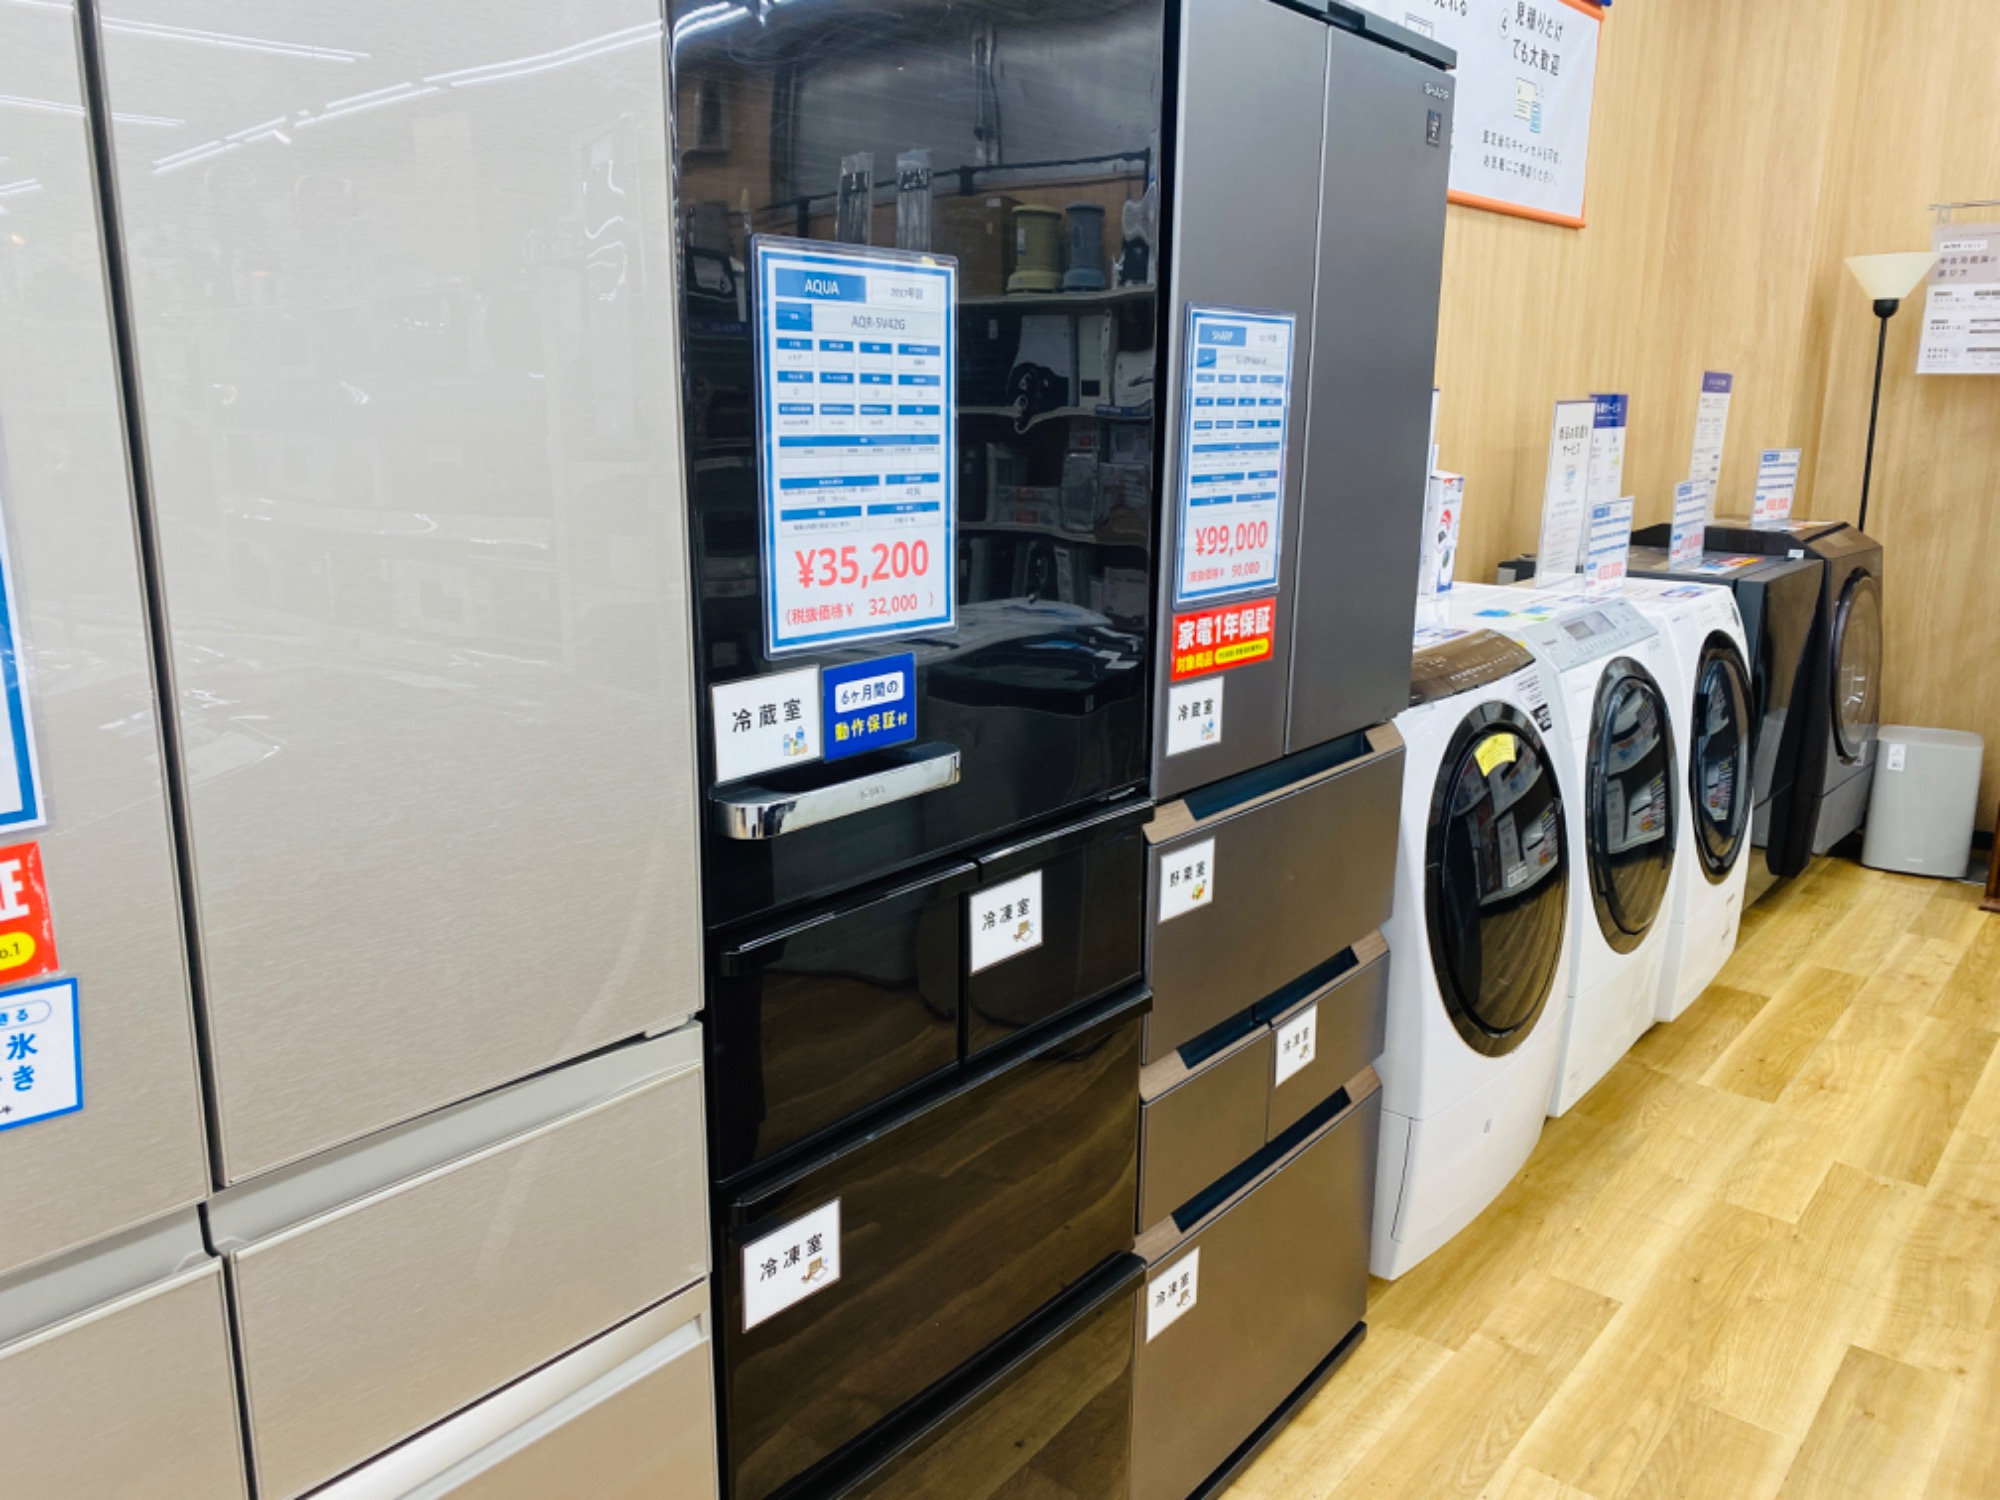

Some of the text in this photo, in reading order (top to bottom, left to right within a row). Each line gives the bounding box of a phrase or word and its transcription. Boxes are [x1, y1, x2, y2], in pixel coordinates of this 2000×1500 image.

[804, 279, 839, 295] AQUA
[1195, 520, 1269, 556] ¥99,000
[794, 539, 929, 589] ¥35,200
[869, 593, 918, 617] 32,000
[1177, 605, 1271, 650] 家電1年保証
[732, 698, 802, 733] 冷蔵室
[834, 710, 907, 742] 動作保証付
[981, 897, 1031, 932] 冷凍室
[6, 1032, 38, 1060] 氷
[759, 1232, 823, 1283] 冷凍室
